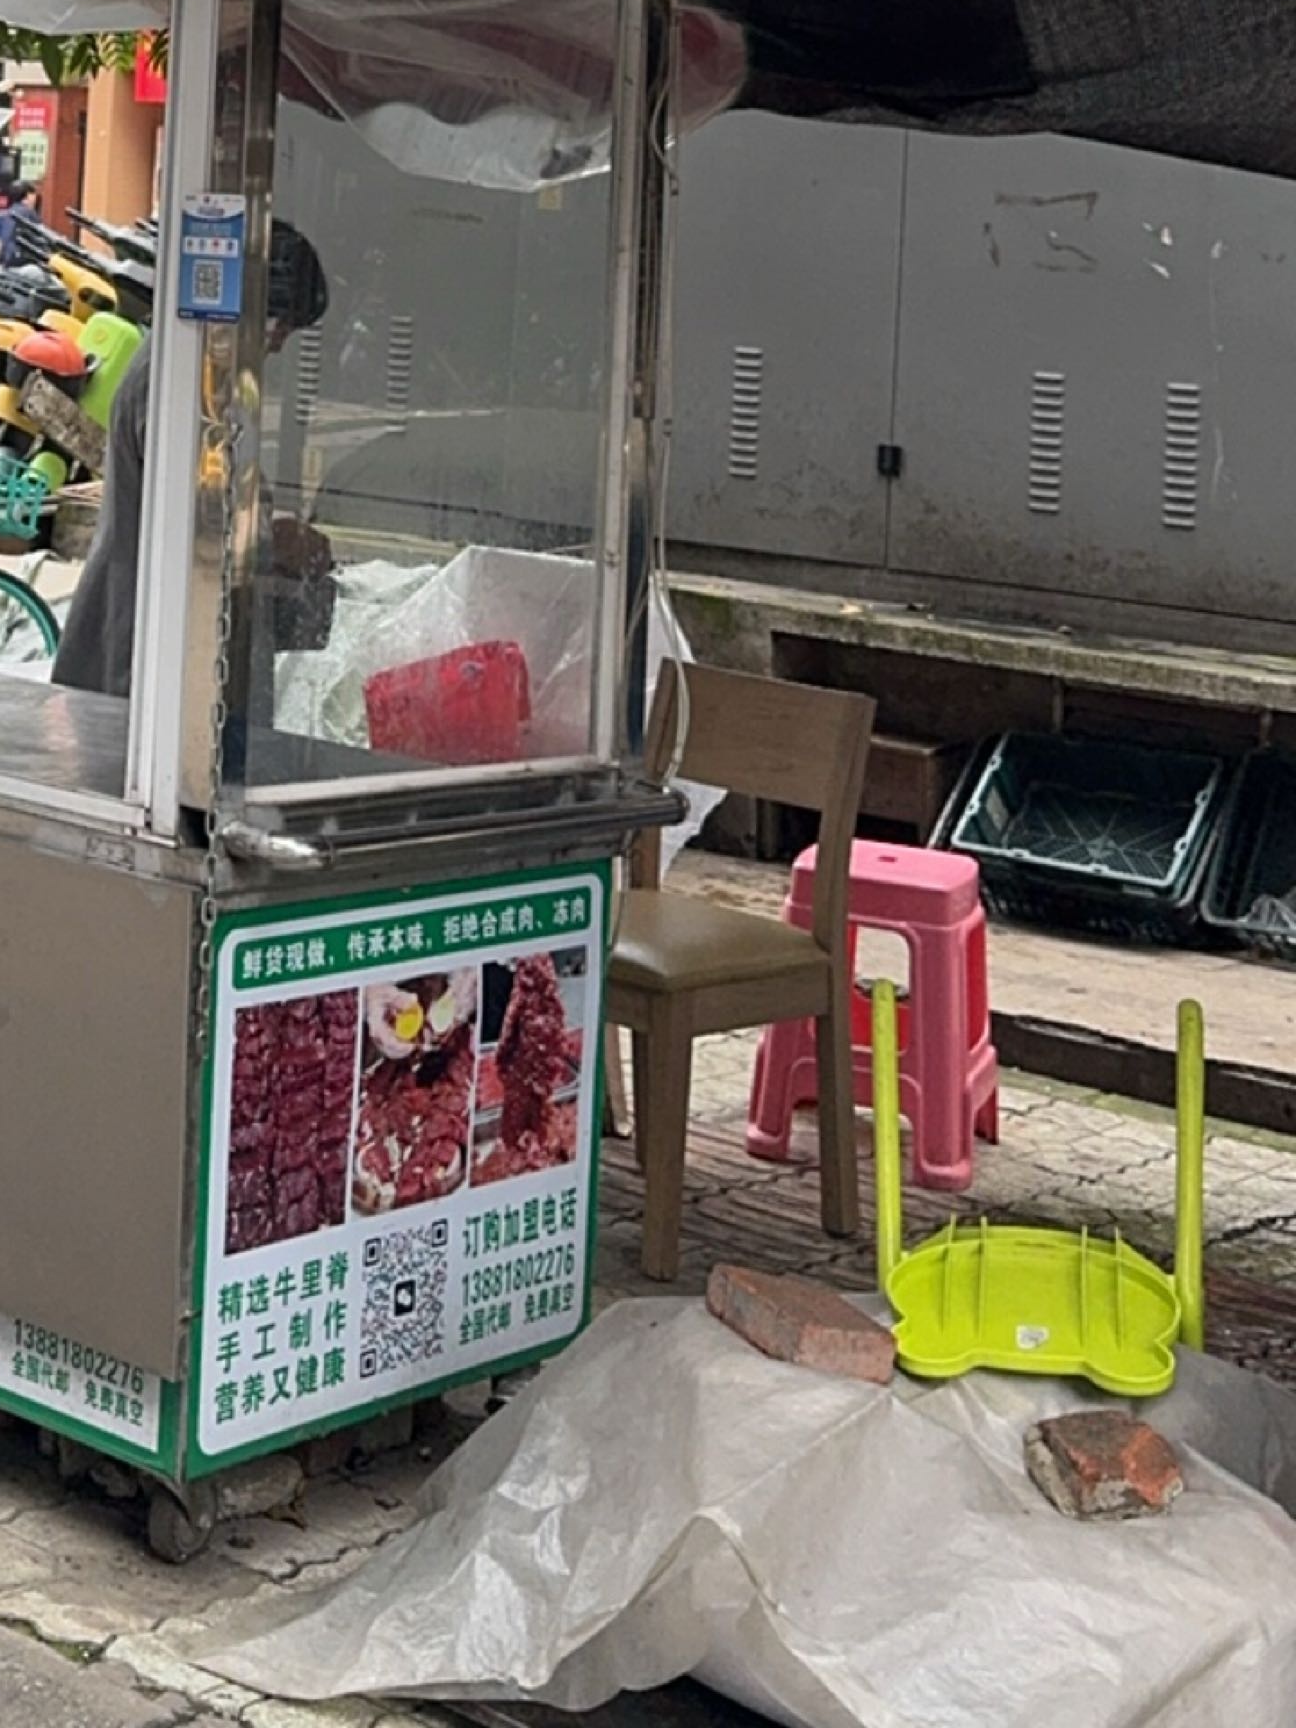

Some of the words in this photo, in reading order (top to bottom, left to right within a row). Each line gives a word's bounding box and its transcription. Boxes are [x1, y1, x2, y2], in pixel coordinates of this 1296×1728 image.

[462, 1187, 577, 1259] 订购加盟电话
[218, 1251, 349, 1325] 精选牛里脊
[462, 1242, 575, 1308] 13881802276
[14, 1318, 144, 1395] 13881802276
[216, 1299, 347, 1374] 手工制作
[214, 1346, 346, 1425] 营养又健康
